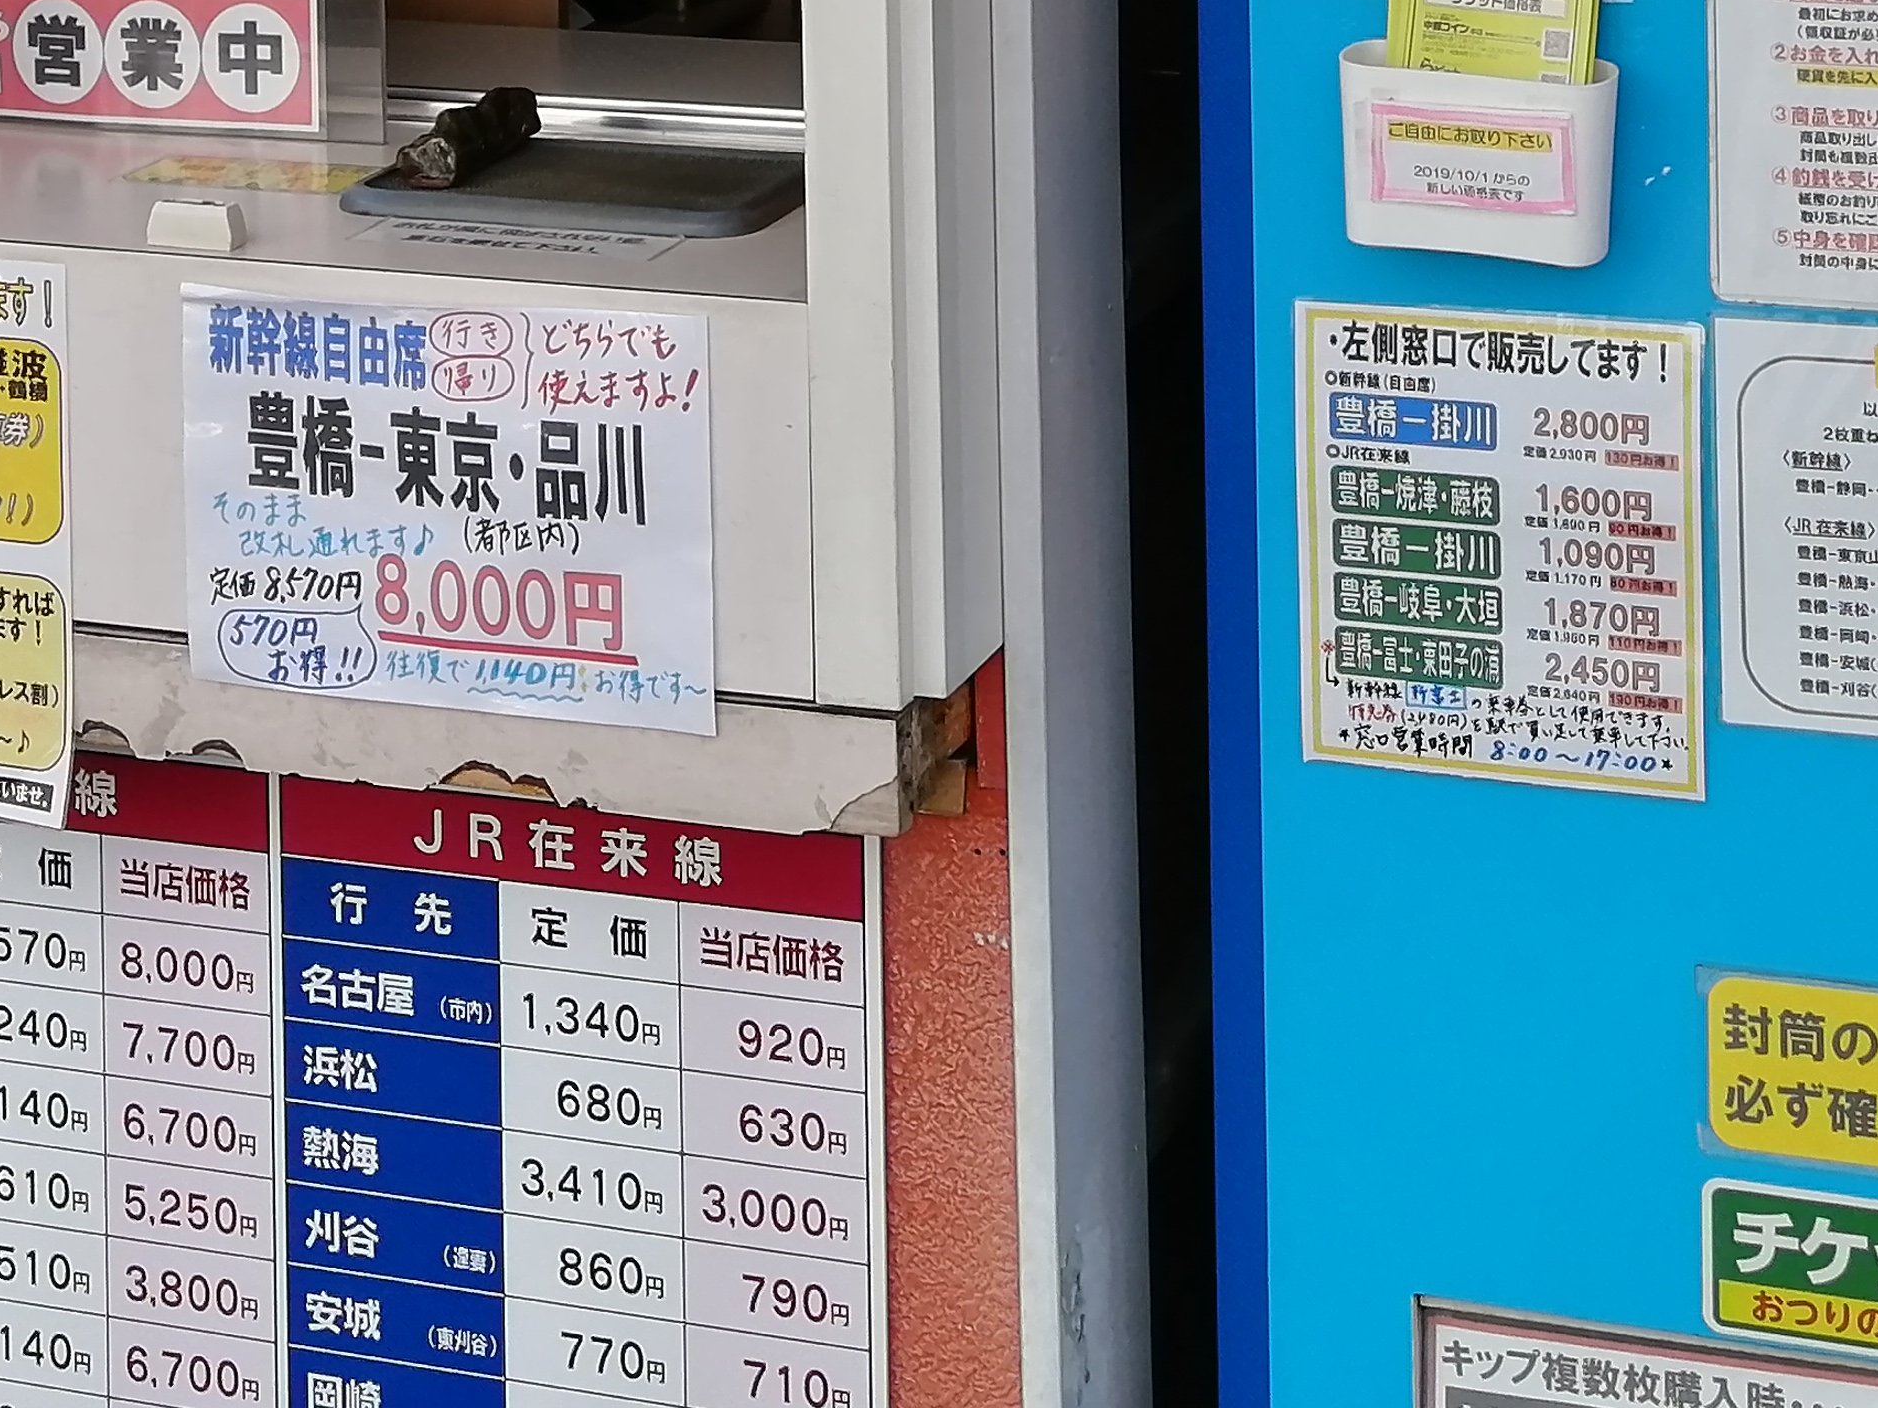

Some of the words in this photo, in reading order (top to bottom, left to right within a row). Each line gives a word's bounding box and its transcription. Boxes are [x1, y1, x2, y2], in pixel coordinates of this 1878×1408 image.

[26, 14, 285, 98] 営業中
[1387, 122, 1553, 150] ご自由にお取り下さい
[208, 304, 427, 392] 新幹線自由席
[441, 318, 501, 352] 行き
[541, 319, 678, 360] どちらでも
[441, 364, 501, 395] 帰り
[537, 369, 699, 413] 使えますよ!
[1532, 407, 1651, 445] 2,800円
[212, 492, 308, 527] そのまま
[1534, 483, 1653, 522] 1,600円
[1539, 537, 1656, 575] 1,090円
[209, 567, 255, 605] 定価
[263, 568, 363, 605] 8,570円
[375, 554, 623, 653] 8,000円
[228, 615, 319, 646] 570円
[1543, 598, 1661, 638] 1,870円
[1544, 652, 1662, 693] 2,450円
[119, 858, 252, 912] 当店価格
[121, 941, 255, 995] 8,000円
[698, 926, 845, 984] 当店価格
[301, 964, 415, 1018] 名古屋
[522, 992, 661, 1047] 1,340円
[737, 1019, 847, 1071] 920円
[122, 1022, 256, 1076] 7,700円
[302, 1044, 379, 1092] 浜松
[556, 1079, 663, 1131] 680円
[738, 1104, 848, 1156] 630円
[123, 1102, 257, 1158] 6,700円
[302, 1126, 380, 1176] 熱海
[521, 1158, 664, 1216] 3,410円
[701, 1183, 849, 1241] 3,000円
[124, 1184, 258, 1239] 5,250円
[124, 1264, 259, 1322] 3,800円
[305, 1209, 381, 1259] 刈谷
[558, 1247, 665, 1300] 860円
[741, 1273, 850, 1328] 790円
[125, 1345, 260, 1404] 6,700円
[305, 1290, 382, 1341] 安城
[559, 1330, 666, 1385] 770円
[742, 1359, 851, 1408] 710円
